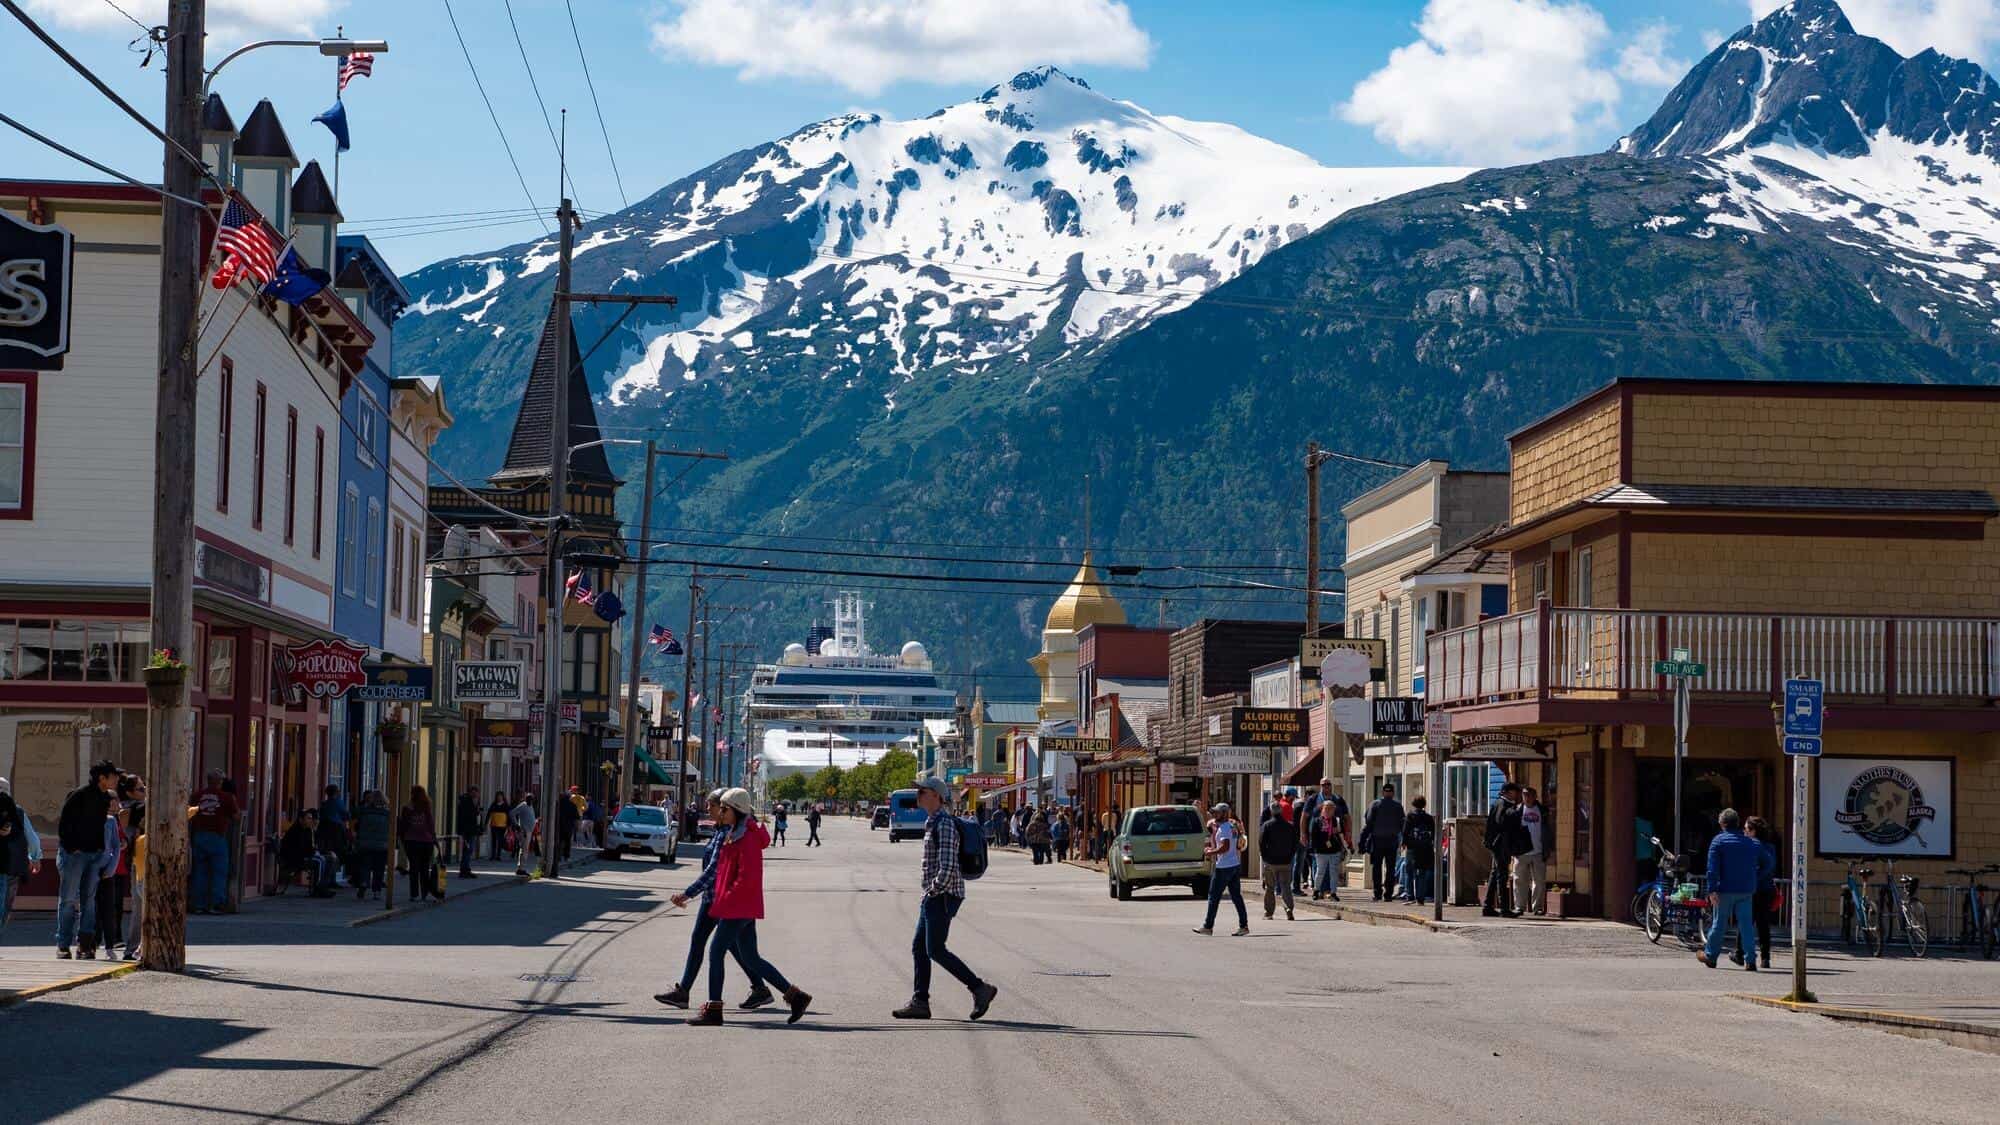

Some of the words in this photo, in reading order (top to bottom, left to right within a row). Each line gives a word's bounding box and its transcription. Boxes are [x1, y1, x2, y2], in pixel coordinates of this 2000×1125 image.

[0, 258, 48, 327] S
[1311, 643, 1375, 651] SKAGWAY
[297, 655, 357, 673] POPCORN
[1663, 663, 1679, 673] 5TH
[1682, 664, 1697, 675] AVE
[457, 666, 519, 685] SKAGWAY
[472, 682, 505, 690] TOURS
[1788, 684, 1819, 692] SMART
[1244, 711, 1297, 721] KLONDIKE
[1376, 701, 1406, 722] KONE
[1240, 722, 1269, 731] GOLD
[1272, 722, 1300, 732] RUSH
[1250, 733, 1291, 742] JEWELS
[1462, 733, 1508, 745] KLOTHES
[1510, 734, 1536, 746] RUSH
[1055, 740, 1110, 751] PANTHEON
[1792, 742, 1813, 750] END
[1854, 767, 1892, 790] KLOTHES
[1797, 841, 1805, 929] TRANSIT
